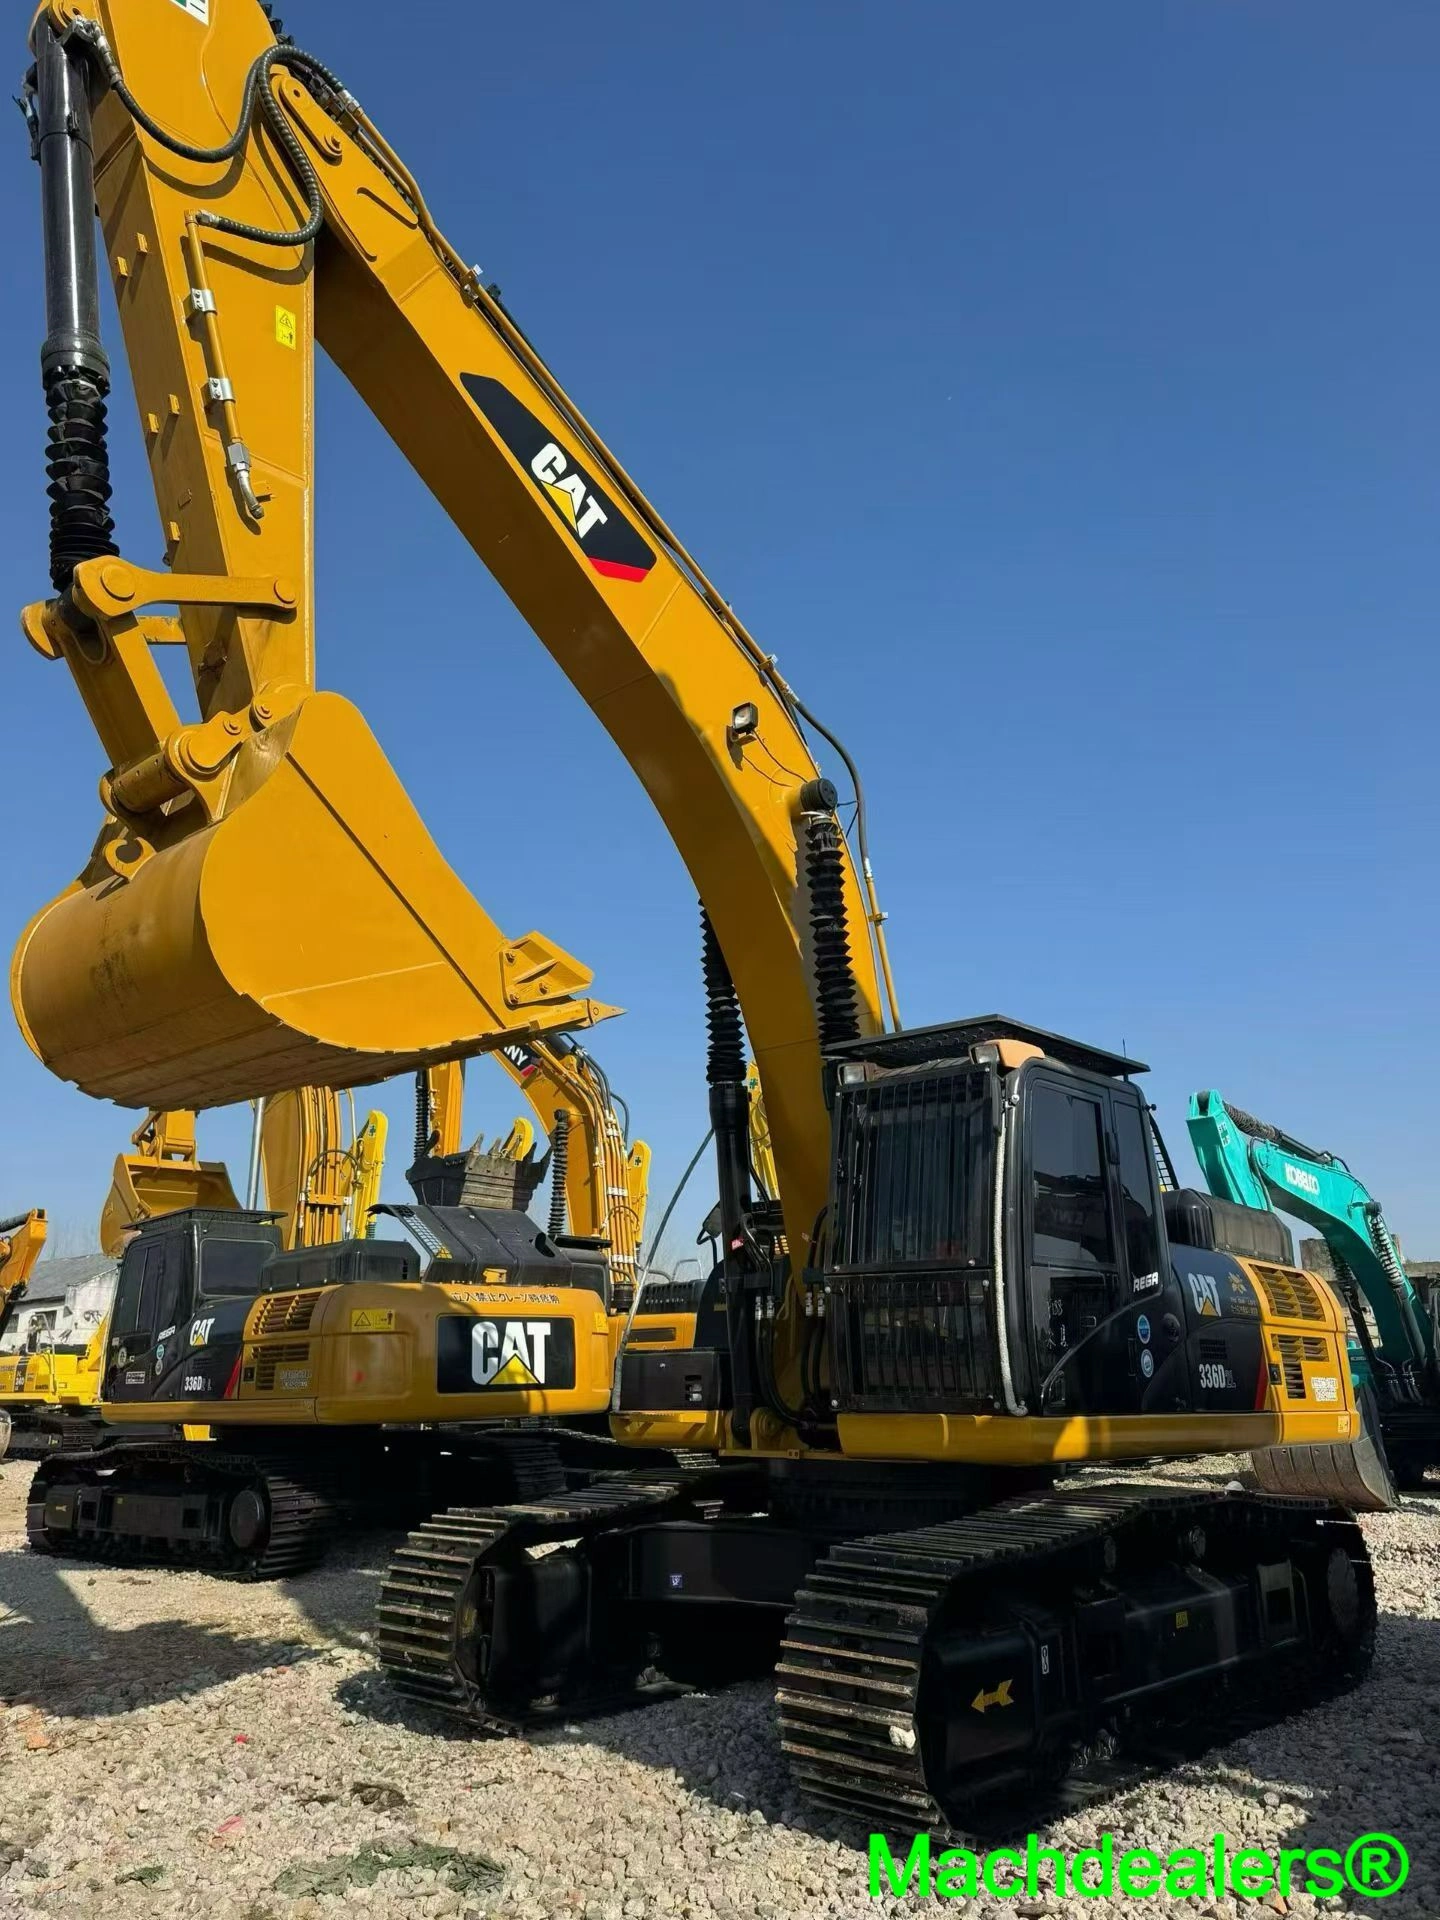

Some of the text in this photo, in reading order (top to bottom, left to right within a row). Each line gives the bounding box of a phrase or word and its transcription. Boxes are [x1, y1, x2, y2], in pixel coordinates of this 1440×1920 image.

[531, 442, 608, 539] CAT
[504, 1045, 528, 1066] NY
[1284, 1161, 1321, 1196] KOBELCO
[1133, 1271, 1159, 1293] REGA
[1188, 1272, 1222, 1317] CAT
[189, 1317, 215, 1346] CAT
[472, 1321, 551, 1385] CAT
